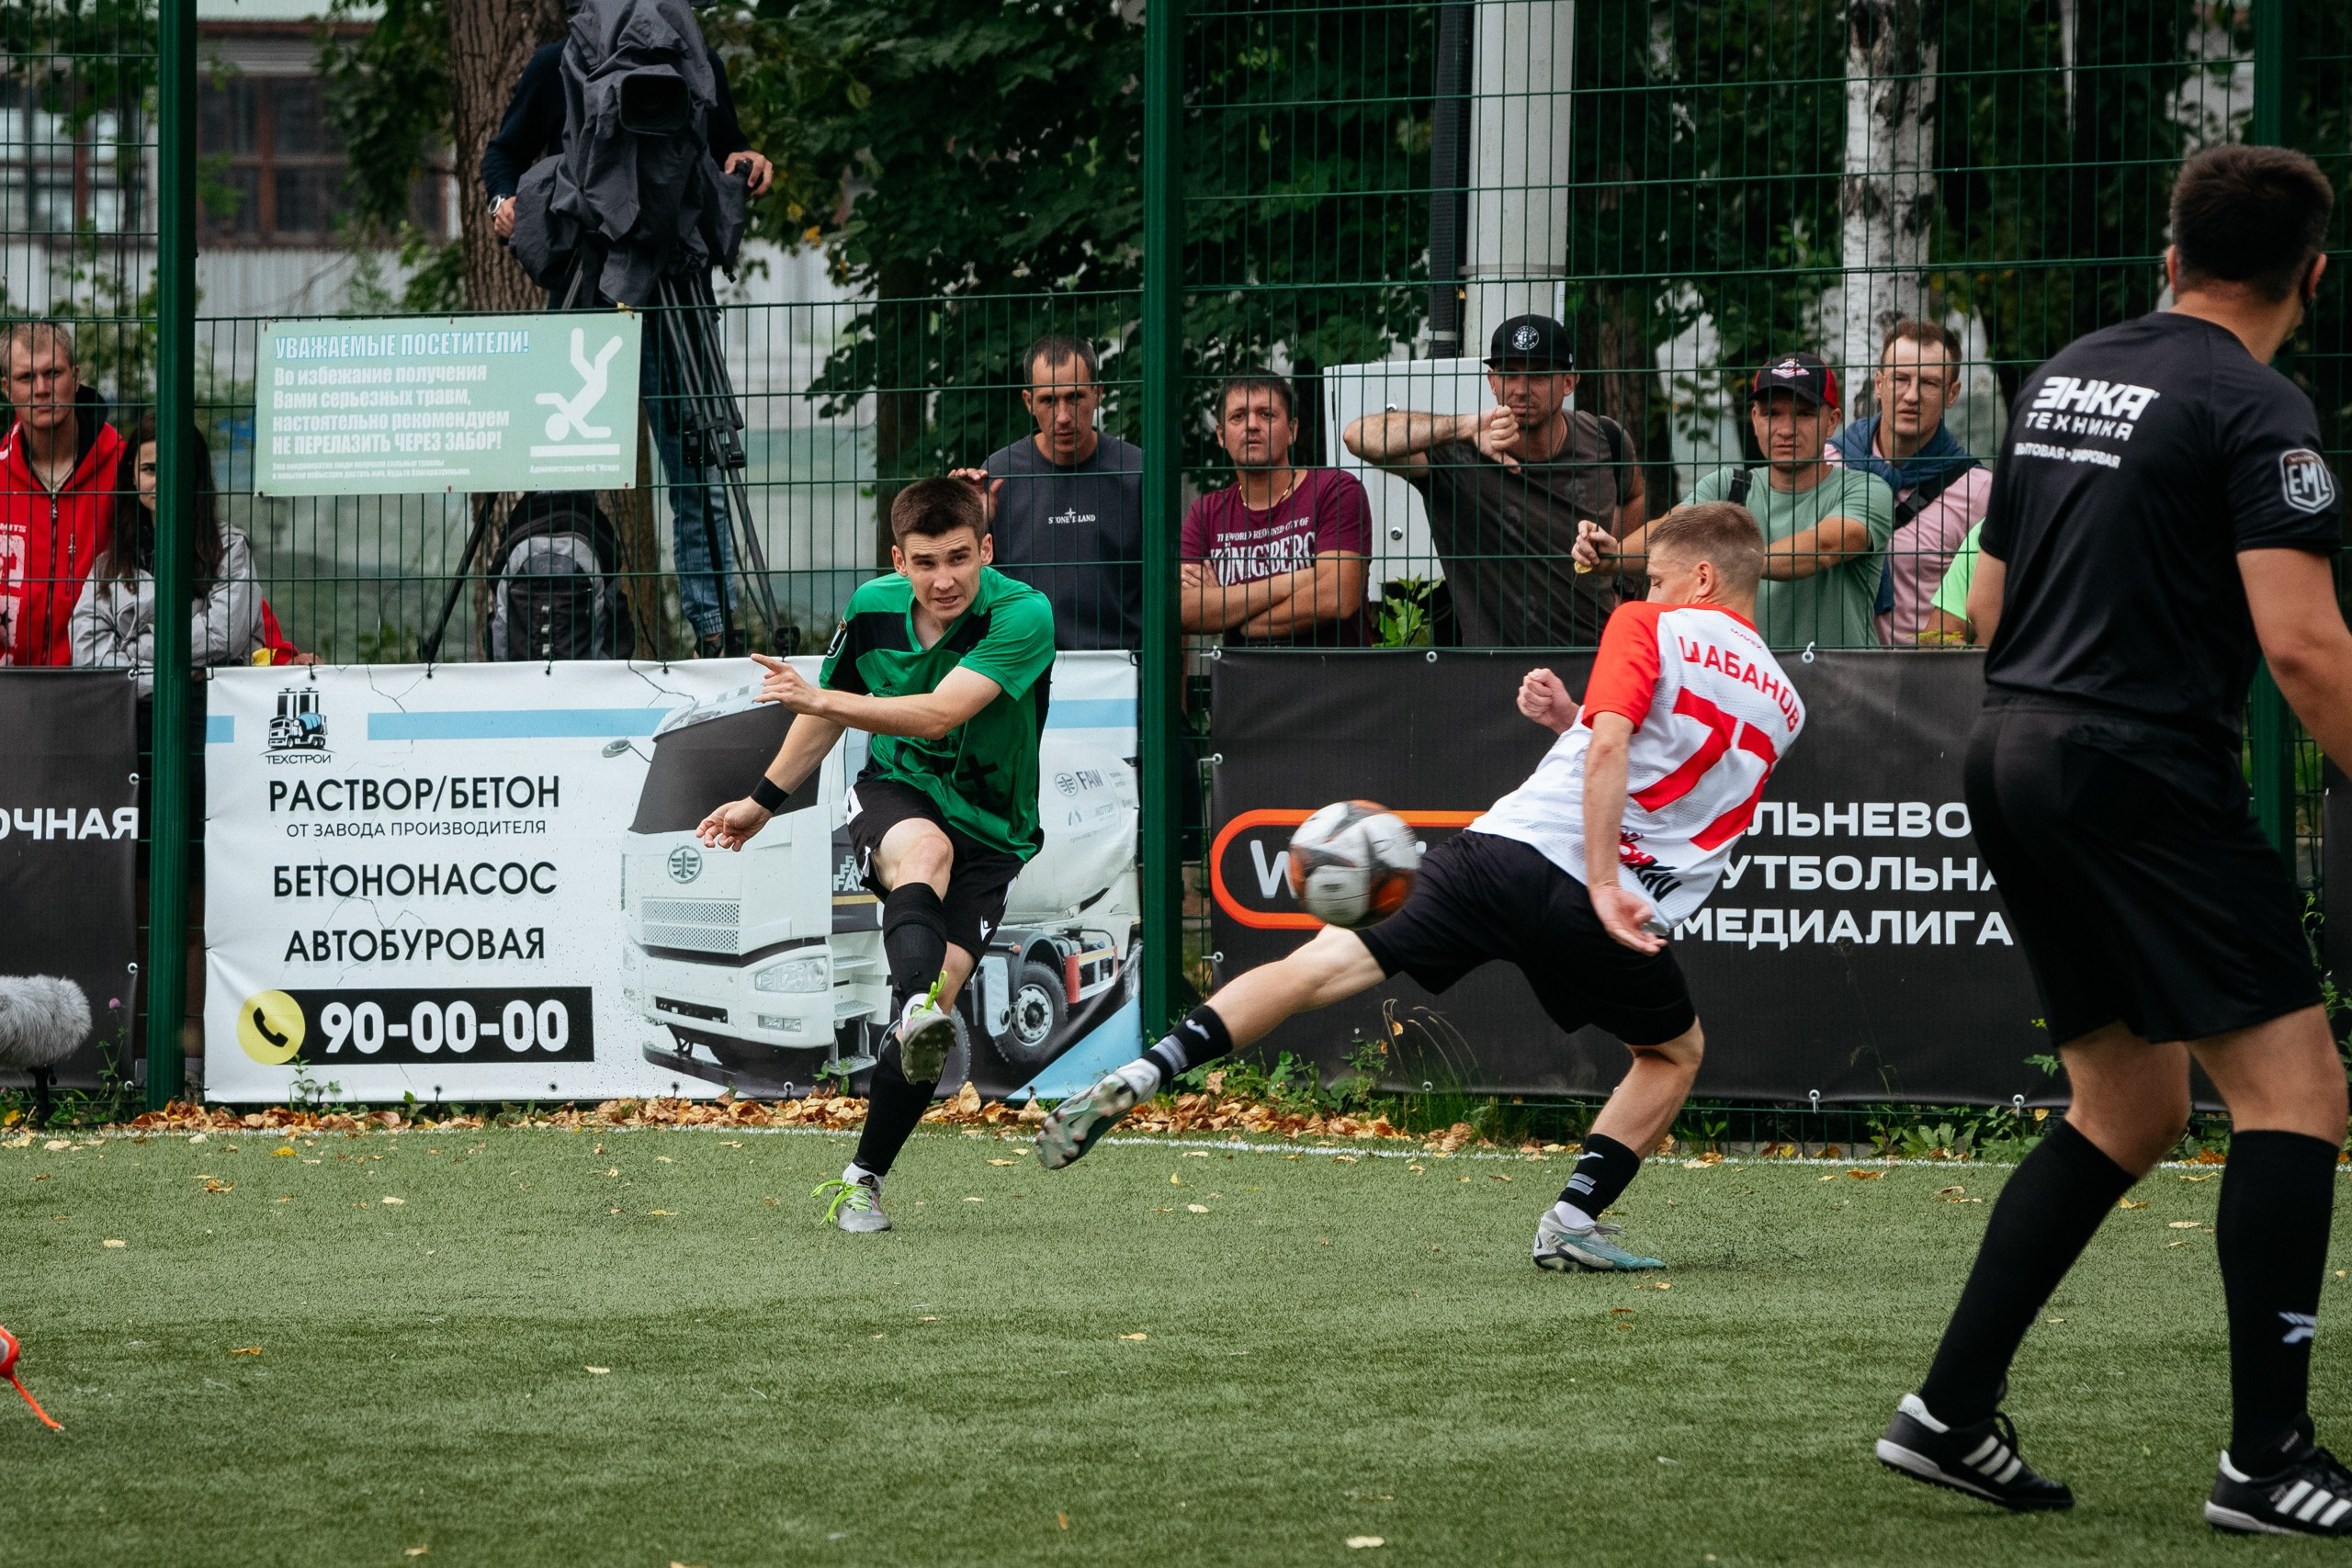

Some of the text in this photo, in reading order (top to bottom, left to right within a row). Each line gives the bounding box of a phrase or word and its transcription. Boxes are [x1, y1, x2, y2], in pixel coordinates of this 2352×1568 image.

[275, 330, 530, 359] УВАЖАЕМЫЕ ПОСЕТИТЕЛИ!
[274, 365, 488, 386] Во избежание получения
[273, 388, 471, 410] Вами серьезных травм,
[2032, 376, 2156, 421] ЭНКА
[273, 411, 510, 432] настоятельно рекомендуем
[2025, 412, 2134, 441] ТЕХНИКА
[272, 431, 503, 456] НЕ ПЕРЕЛАЗИТЬ ЧЕРЕЗ ЗАБОР!
[2013, 442, 2066, 460] БЫТОВАЯ
[1071, 513, 1096, 524] ILAND
[1298, 516, 1310, 526] OF
[1075, 769, 1103, 790] FAW
[269, 775, 560, 813] РАСТВОР/БЕТОН
[287, 820, 547, 839] ОТ ЗАВОДА ПРОИЗВОДИТЕЛЯ
[1746, 802, 1973, 839] ЛЬНЕВО
[274, 862, 558, 897] БЕТОНОНАСОС
[1673, 908, 2014, 951] МЕДИАЛИГА
[284, 927, 545, 962] АВТОБУРОВАЯ
[320, 998, 569, 1054] 90-00-00
